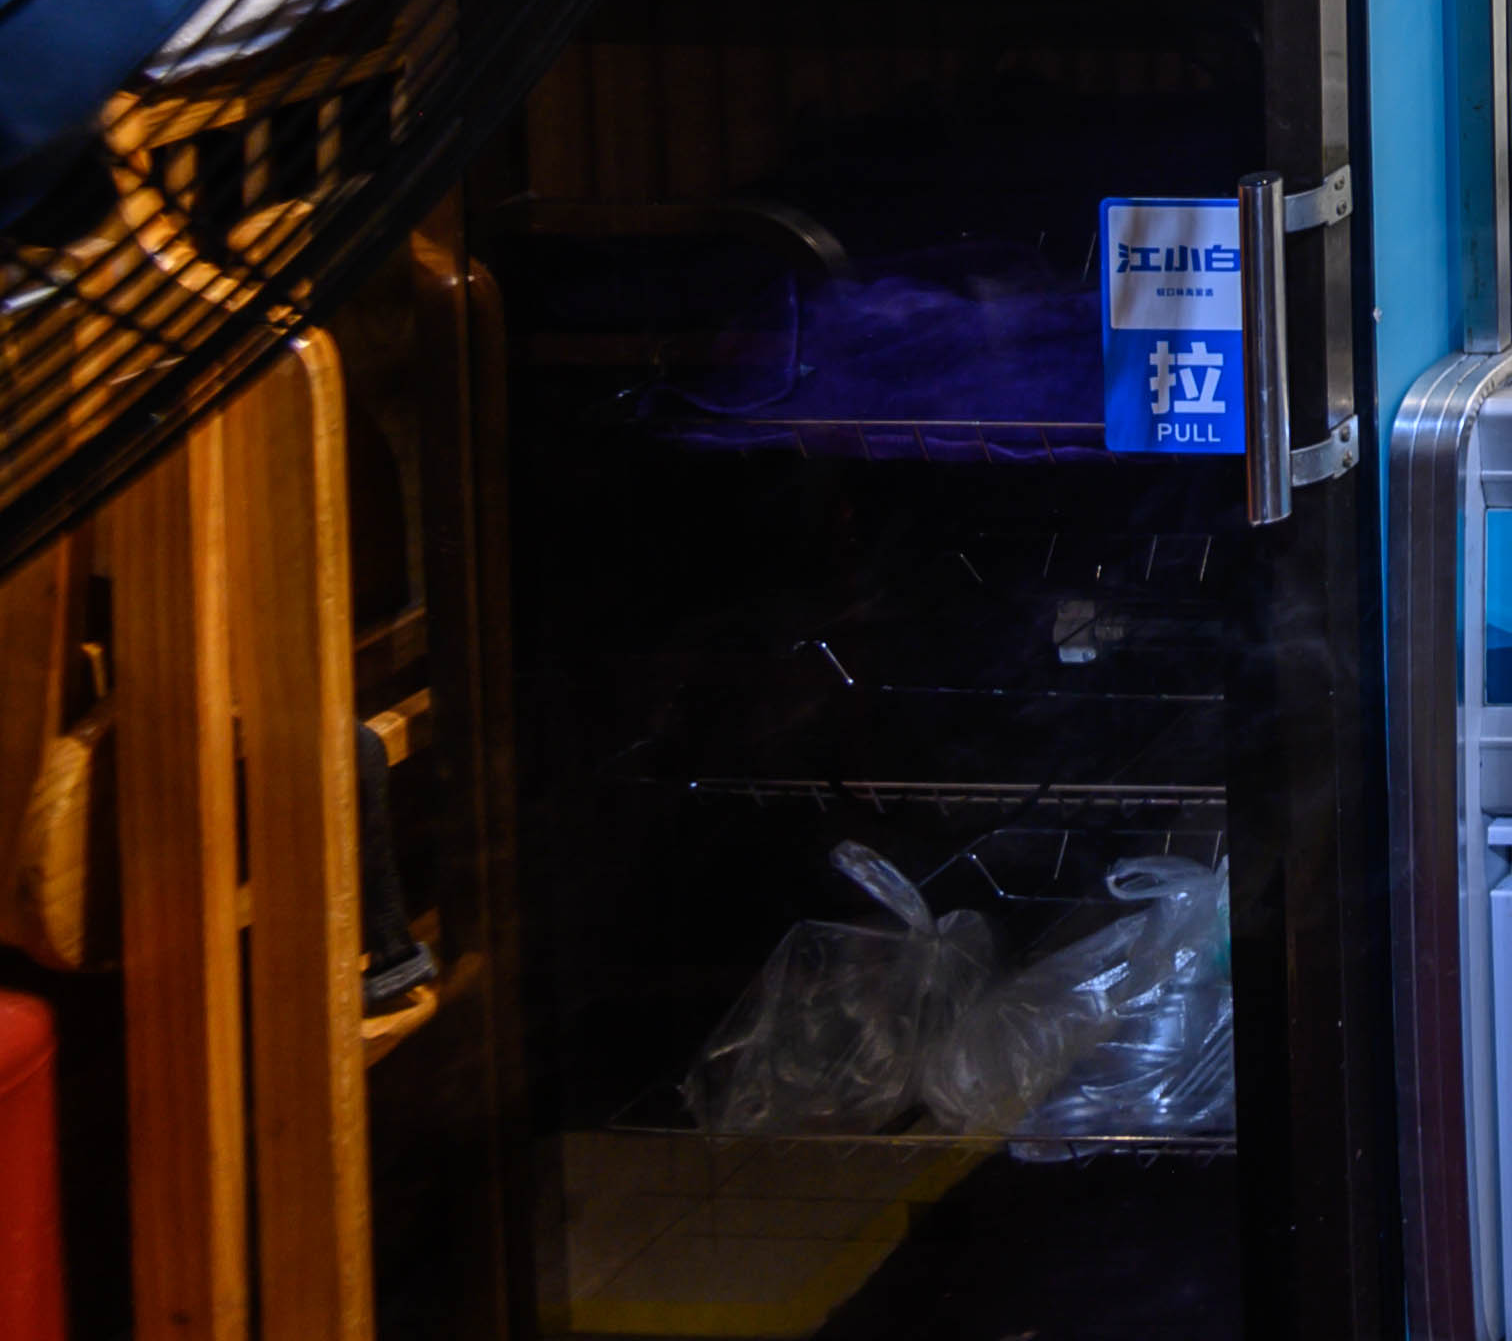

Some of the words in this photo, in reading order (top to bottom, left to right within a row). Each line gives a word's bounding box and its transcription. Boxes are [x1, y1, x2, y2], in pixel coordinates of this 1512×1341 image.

[1116, 243, 1241, 273] 江小白
[1149, 340, 1226, 415] 拉
[1157, 423, 1221, 442] PULL
